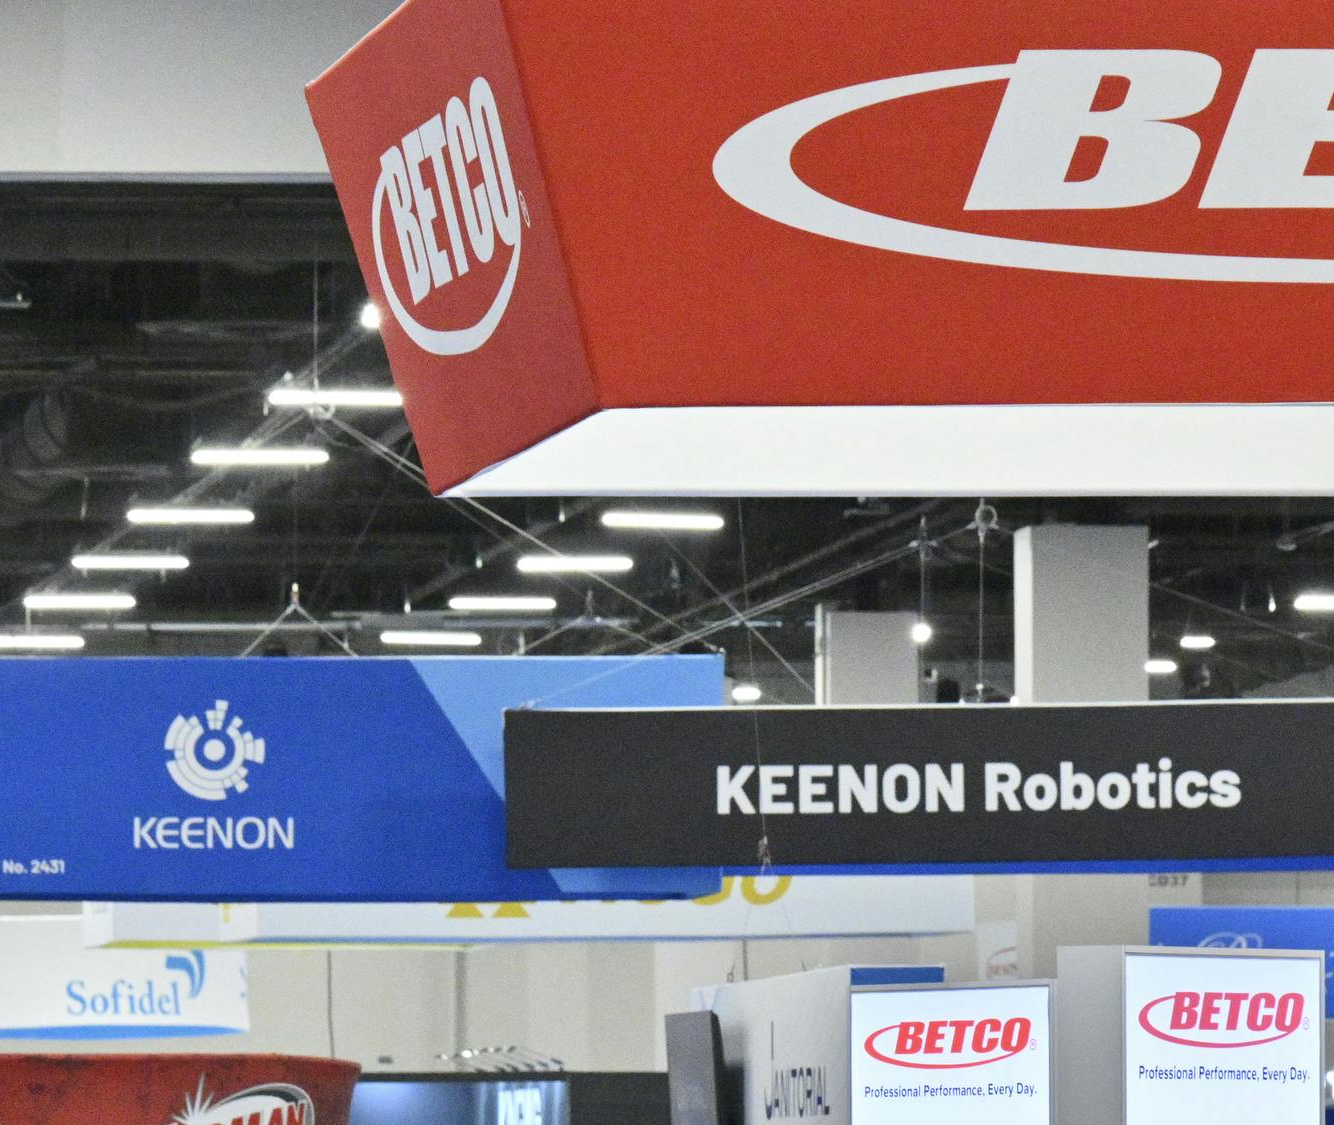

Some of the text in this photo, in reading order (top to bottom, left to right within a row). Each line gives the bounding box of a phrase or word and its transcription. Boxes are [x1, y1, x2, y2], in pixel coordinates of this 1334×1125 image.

[381, 76, 521, 306] BETCO
[716, 757, 1242, 816] KEENON Robotics
[133, 816, 295, 849] KEENON
[2, 860, 28, 875] No.
[31, 859, 66, 875] 2431
[66, 978, 182, 1017] Sofidel
[1170, 991, 1305, 1032] BETCO
[895, 1017, 1031, 1055] BETCO
[864, 1082, 1038, 1098] Professional Performance, Every Day.
[1139, 1065, 1311, 1083] Professional Performance, Every Day.
